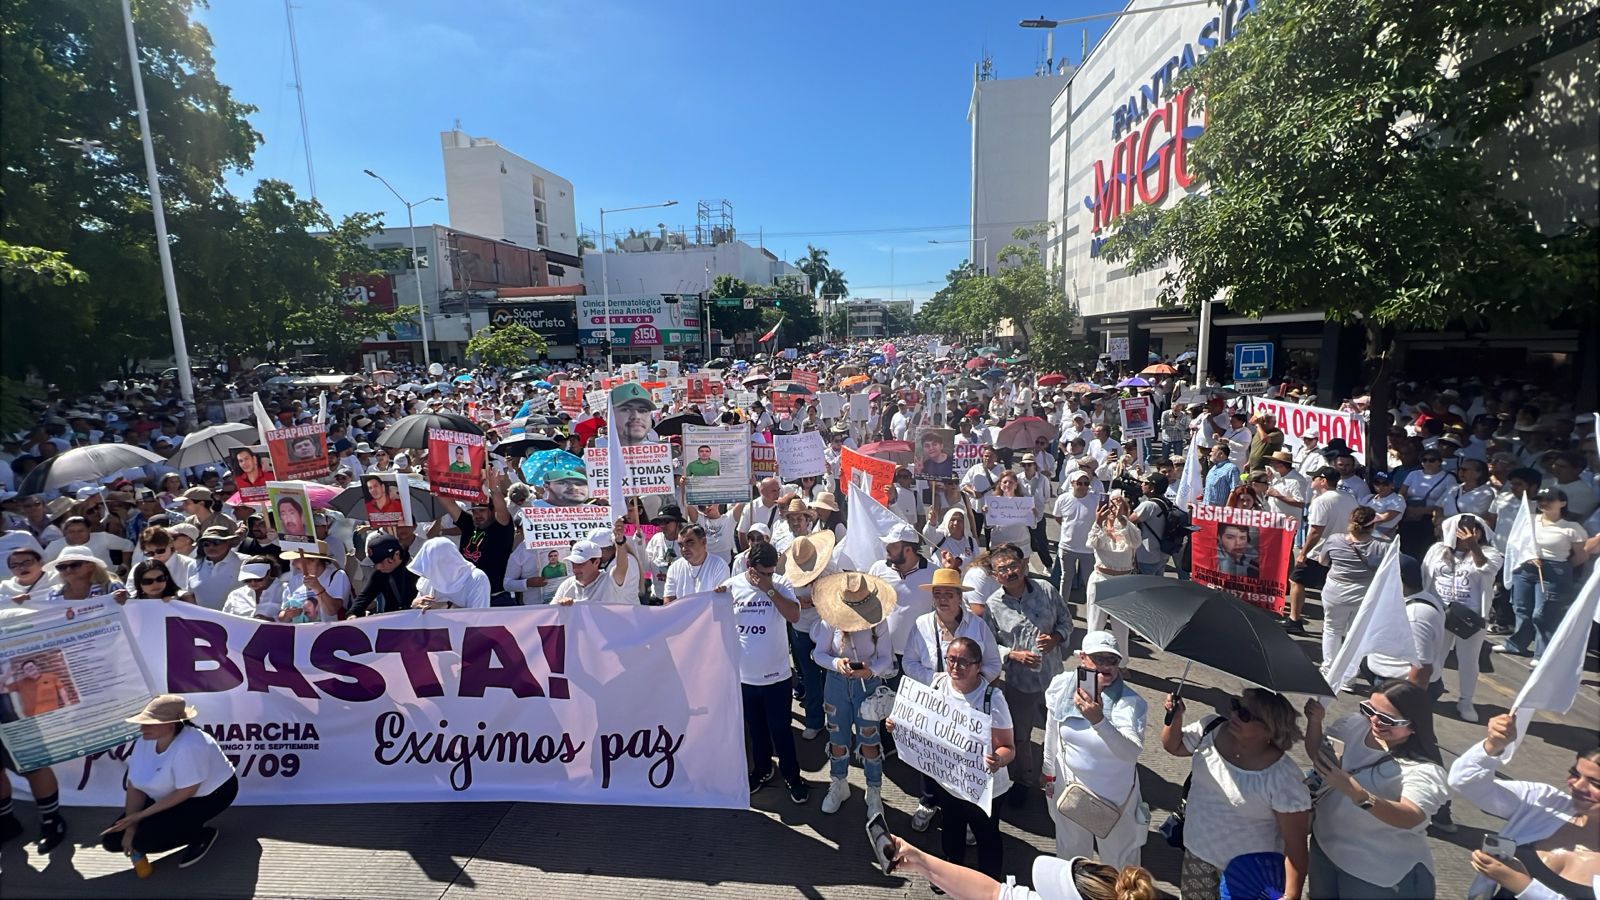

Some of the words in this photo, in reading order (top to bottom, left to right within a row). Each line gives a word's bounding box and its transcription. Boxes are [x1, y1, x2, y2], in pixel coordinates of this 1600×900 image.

[608, 298, 660, 308] Dermatológica
[513, 308, 544, 319] Súper
[634, 328, 656, 340] $150
[1292, 409, 1363, 454] OCHOA
[587, 444, 668, 457] DESARECIDO
[590, 468, 608, 478] JES
[630, 465, 672, 476] TOMAS
[632, 476, 666, 486] FELIX
[525, 506, 608, 514] DESAPARECIDO
[527, 523, 568, 532] JESUS
[572, 522, 612, 530] TOMAS
[535, 531, 571, 540] FELIX
[531, 540, 570, 548] ¡ESPERAMO
[1247, 592, 1276, 603] 1930
[77, 625, 121, 640] RODRIGUEZ
[165, 616, 570, 702] BASTA!
[900, 676, 914, 700] El
[915, 690, 950, 718] miedo
[952, 709, 968, 730] que
[969, 718, 983, 734] se
[914, 712, 929, 732] en
[204, 722, 320, 742] MARCHA
[374, 711, 586, 791] Exigimos
[600, 724, 685, 788] paz
